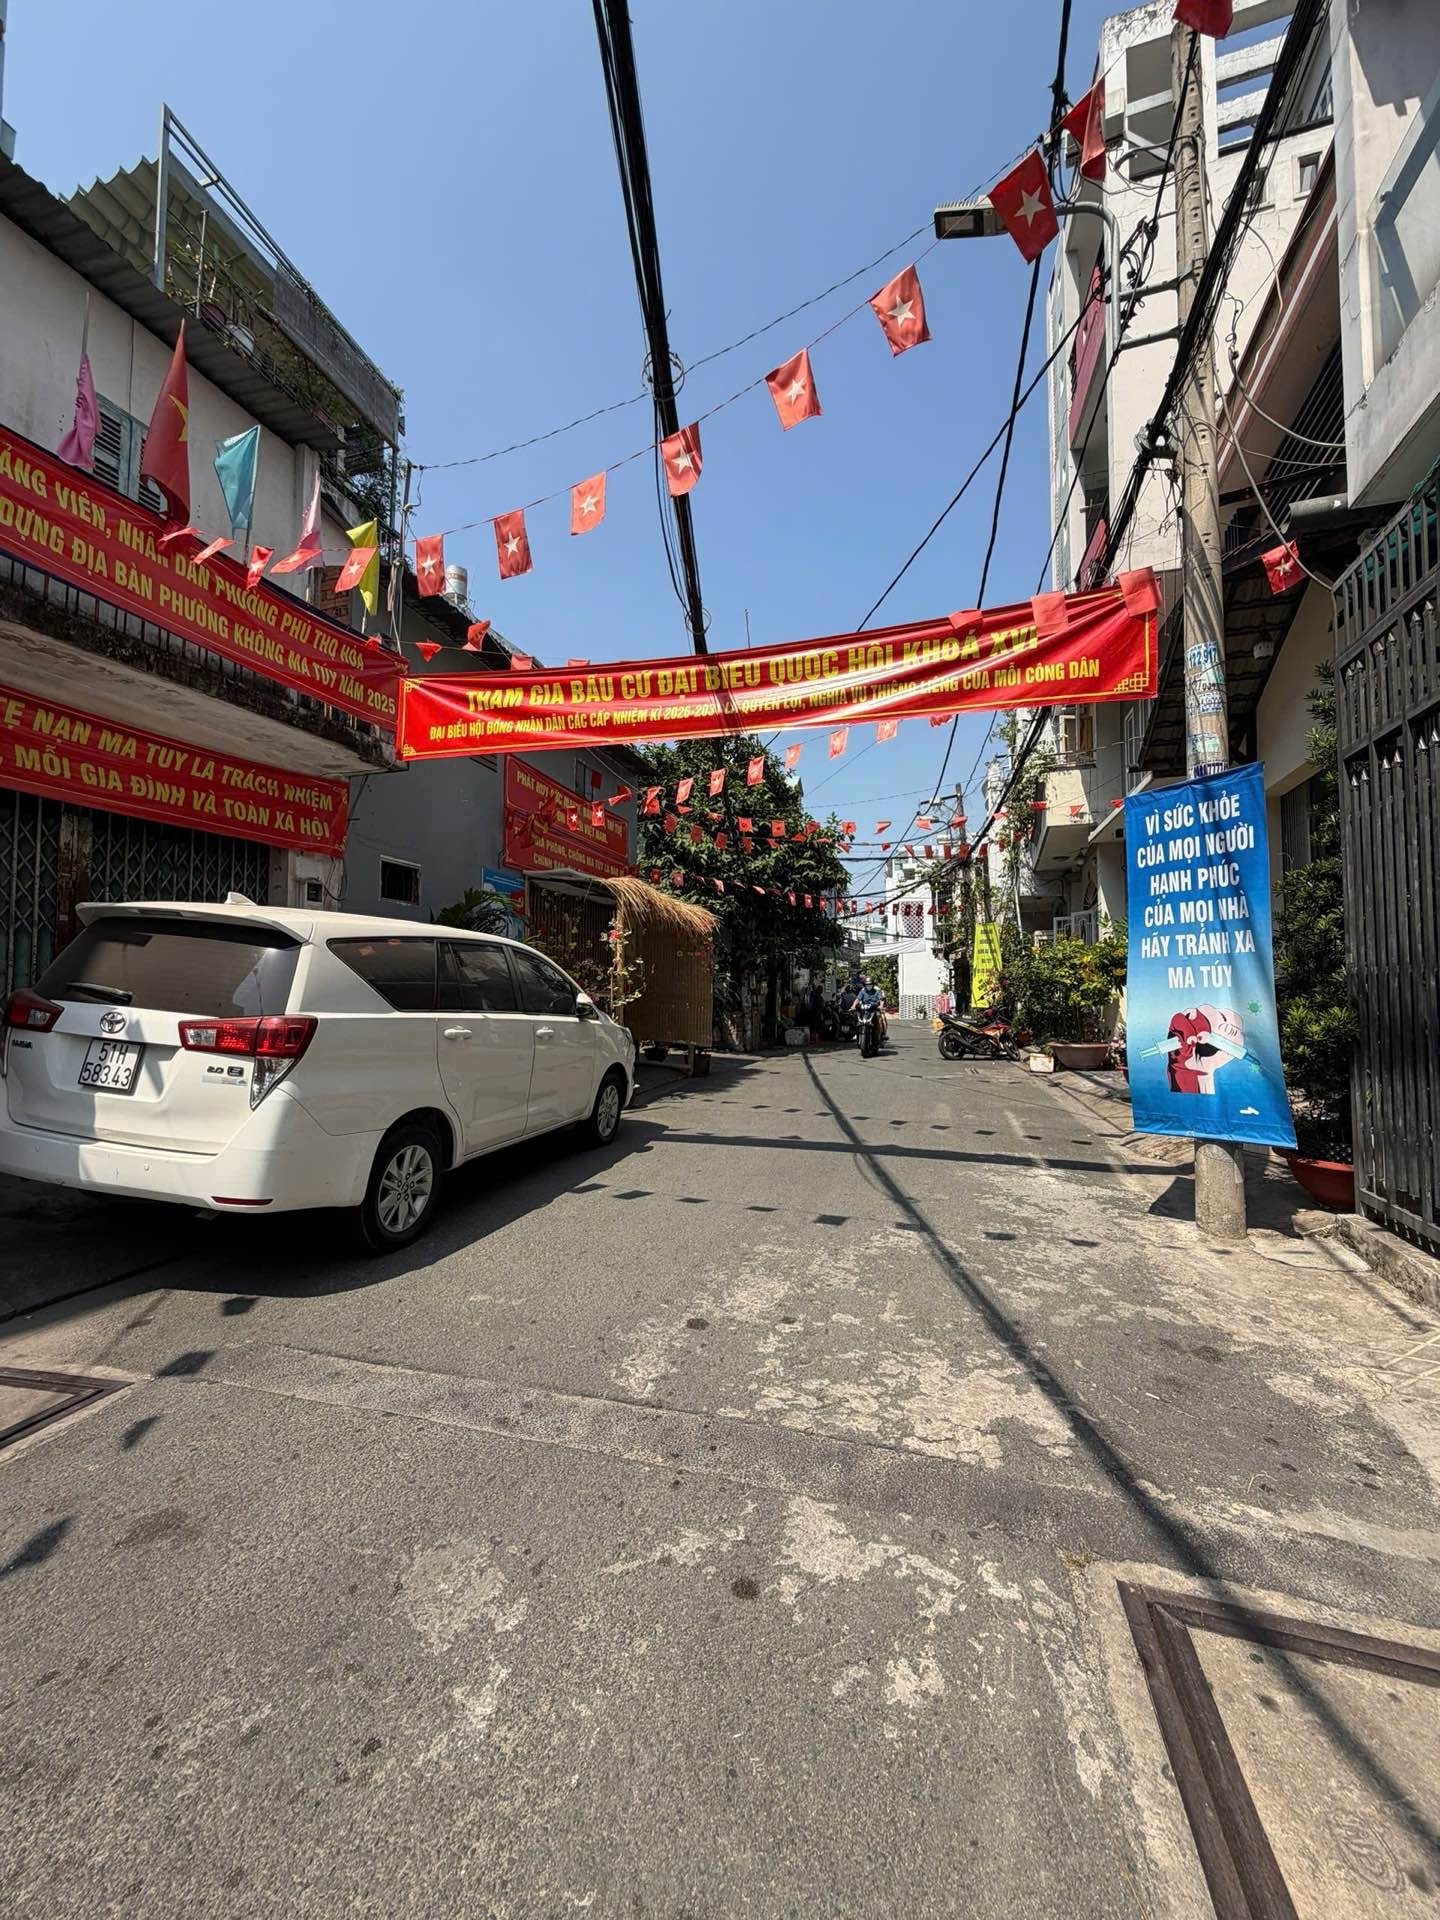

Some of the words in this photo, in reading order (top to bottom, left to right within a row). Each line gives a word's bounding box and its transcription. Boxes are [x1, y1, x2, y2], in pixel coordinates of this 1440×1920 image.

[55, 481, 111, 539] VIÊN,
[215, 576, 278, 627] PHƯỜNG
[281, 612, 312, 644] PHÚ
[313, 629, 338, 661] THỌ
[71, 536, 108, 577] ĐỊA
[115, 559, 152, 601] BÀN
[159, 584, 228, 639] PHƯỜNG
[234, 622, 284, 665] KHÔNG
[288, 650, 310, 677] MA
[312, 662, 337, 688] TÚY
[339, 673, 364, 703] NĂM
[367, 689, 396, 715] 2025
[466, 687, 523, 713] THAM
[529, 683, 565, 706] GIA
[657, 667, 697, 700] ĐẠI
[902, 629, 980, 668] KHOÁ
[990, 625, 1038, 658] XVI
[430, 725, 446, 742] ĐẠI
[447, 718, 467, 739] BIỂU
[469, 718, 485, 740] HỘI
[515, 714, 544, 733] NHÂN
[545, 712, 566, 731] DÂN
[568, 711, 588, 730] CÁC
[613, 705, 647, 727] NHIỆM
[994, 662, 1020, 688] MỖI
[1026, 661, 1065, 684] CÔNG
[1069, 658, 1100, 679] DÂN
[32, 708, 91, 744] NẠN
[97, 729, 137, 760] MA
[221, 765, 279, 797] TRÁCH
[284, 783, 333, 812] NHIỆM
[15, 744, 71, 780] MỖI
[80, 763, 123, 793] GIA
[130, 774, 185, 807] ĐÌNH
[192, 788, 217, 815] VÀ
[224, 799, 269, 827] TOÀN
[274, 810, 295, 833] XÃ
[301, 816, 330, 840] HỘI
[1145, 808, 1160, 837] VÌ
[1164, 801, 1194, 833] SỨC
[1198, 790, 1241, 825] KHỎE
[1137, 839, 1165, 869] CỦA
[1168, 835, 1201, 865] MỌI
[1205, 821, 1255, 857] NGƯỜI
[1150, 869, 1191, 899] HẠNH
[1198, 859, 1240, 890] PHÚC
[1144, 897, 1175, 928] CỦA
[1180, 899, 1214, 927] MỌI
[1218, 890, 1249, 921] NHÀ
[1141, 931, 1170, 959] HÃY
[1176, 927, 1231, 957] TRÁNH
[1235, 929, 1256, 953] XA
[1168, 966, 1195, 989] MA
[1200, 959, 1232, 989] TÚY
[81, 1061, 132, 1088] 583.43
[98, 1041, 129, 1065] 51H
